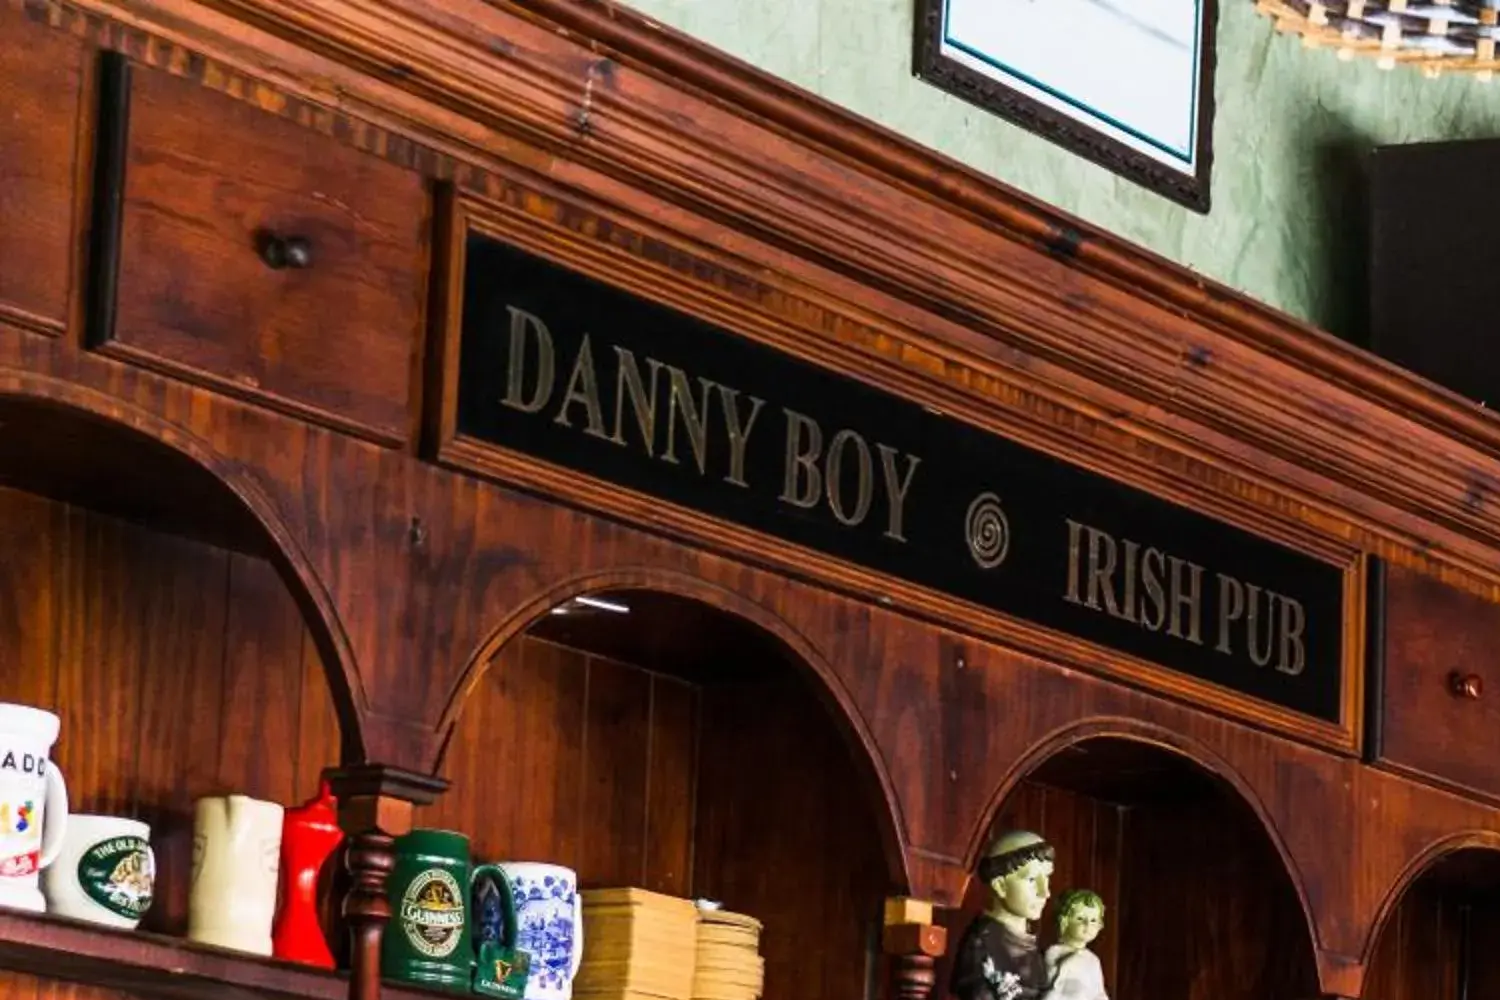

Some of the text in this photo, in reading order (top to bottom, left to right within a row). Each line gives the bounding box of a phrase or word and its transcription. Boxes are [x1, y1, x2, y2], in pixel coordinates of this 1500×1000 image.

[500, 304, 1305, 676] DANNY BOY IRISH PUB
